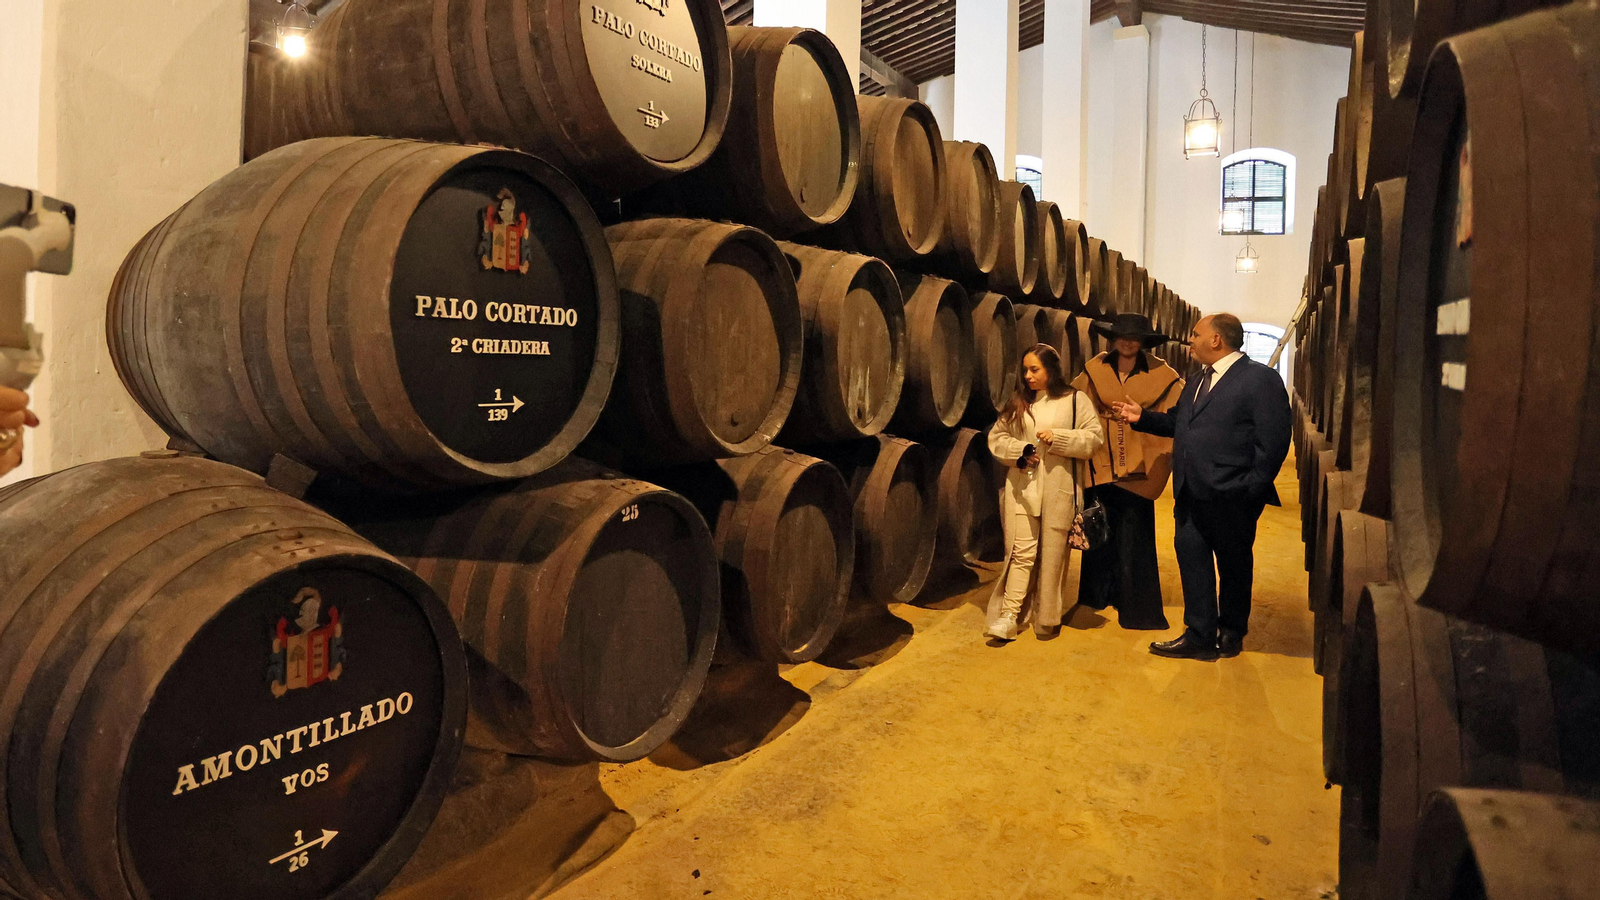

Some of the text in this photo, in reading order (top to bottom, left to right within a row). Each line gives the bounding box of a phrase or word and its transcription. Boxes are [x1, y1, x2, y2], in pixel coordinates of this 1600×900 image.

[592, 5, 701, 72] PALO CORTADO
[631, 54, 673, 82] SOLERA
[648, 100, 654, 111] 1
[644, 116, 660, 128] 133
[415, 295, 578, 327] PALO CORTADO
[471, 338, 551, 356] CRIADERA
[494, 388, 502, 400] 1
[488, 408, 508, 421] 139
[622, 504, 639, 522] 25
[172, 692, 414, 796] AMONTILLADO
[281, 763, 329, 795] VOS
[294, 830, 304, 846] 1
[288, 852, 309, 873] 26
